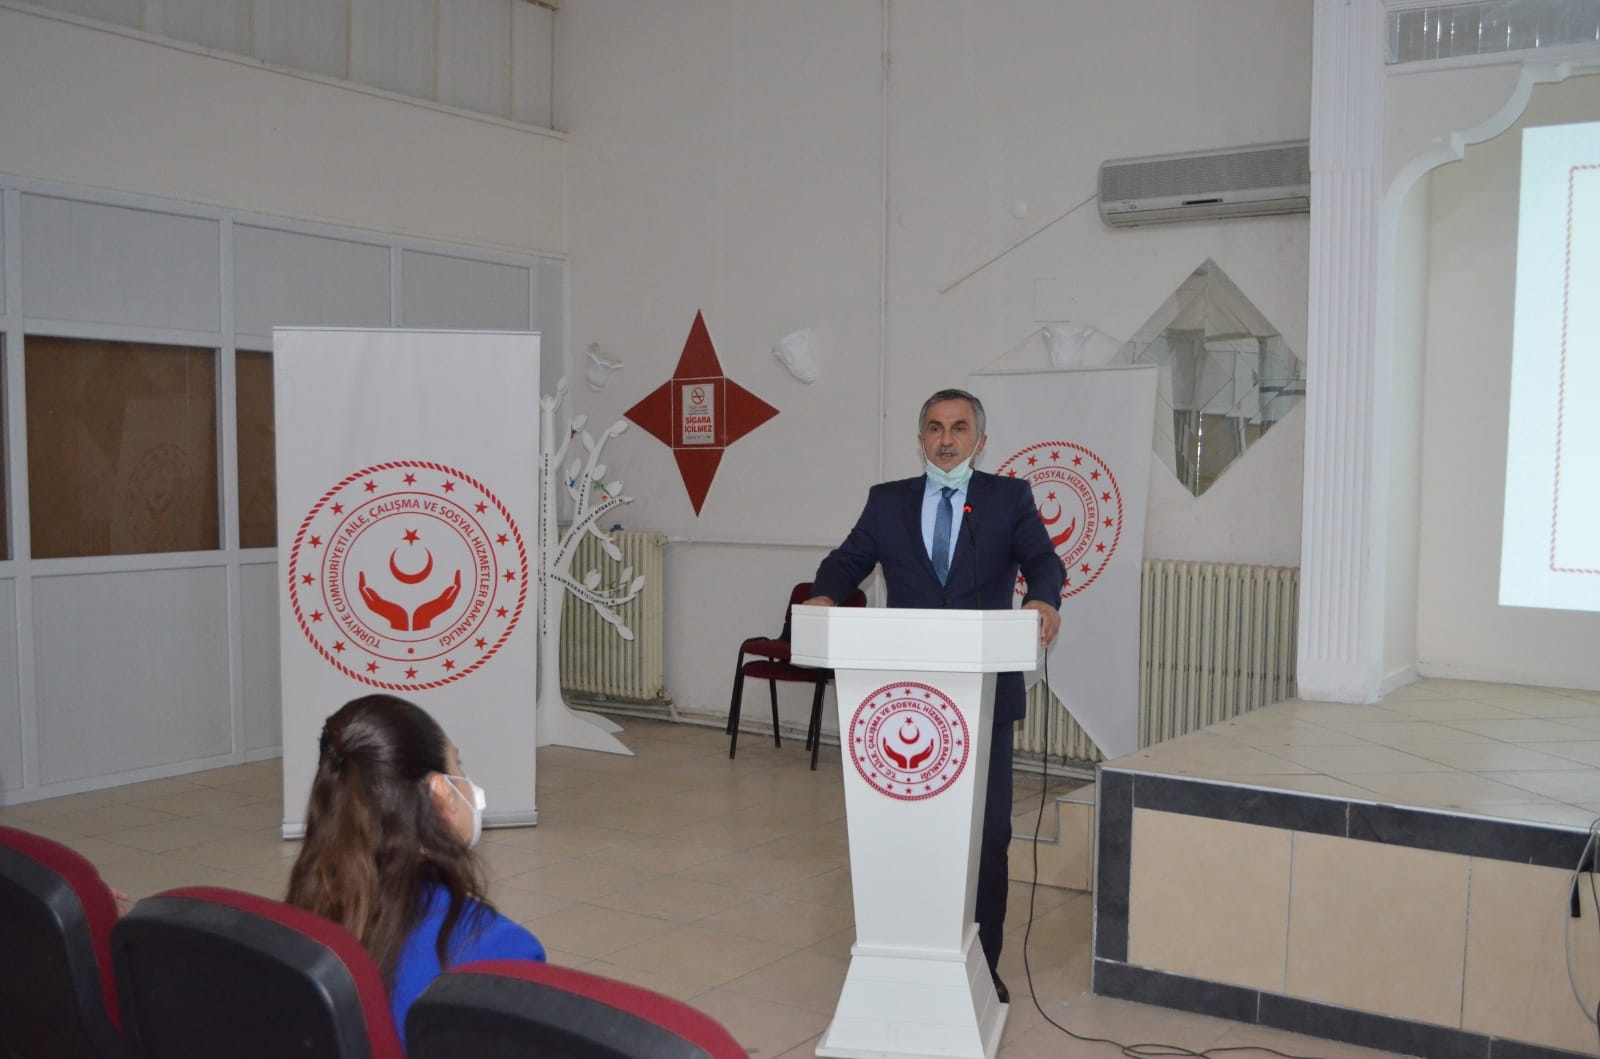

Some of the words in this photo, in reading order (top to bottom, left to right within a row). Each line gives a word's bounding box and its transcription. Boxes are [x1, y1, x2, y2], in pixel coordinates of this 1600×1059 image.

[684, 424, 713, 434] İÇİLMEZ
[369, 499, 420, 519] ÇALIŞMA
[423, 500, 438, 512] VE
[1033, 470, 1066, 482] SOSYAL
[1067, 474, 1096, 520] HİZMETLER
[345, 515, 371, 537] AİLE,
[438, 506, 475, 538] SOSYAL
[328, 536, 350, 613] CUMHURİYETİ
[471, 536, 490, 599] HİZMETLER
[341, 612, 382, 649] TÜRKİYE
[439, 600, 485, 648] BAKANLIĞI
[880, 706, 891, 716] VE
[890, 701, 922, 711] SOSYAL
[923, 705, 950, 745] HİZMETLER
[920, 746, 950, 780] BAKANLIĞI
